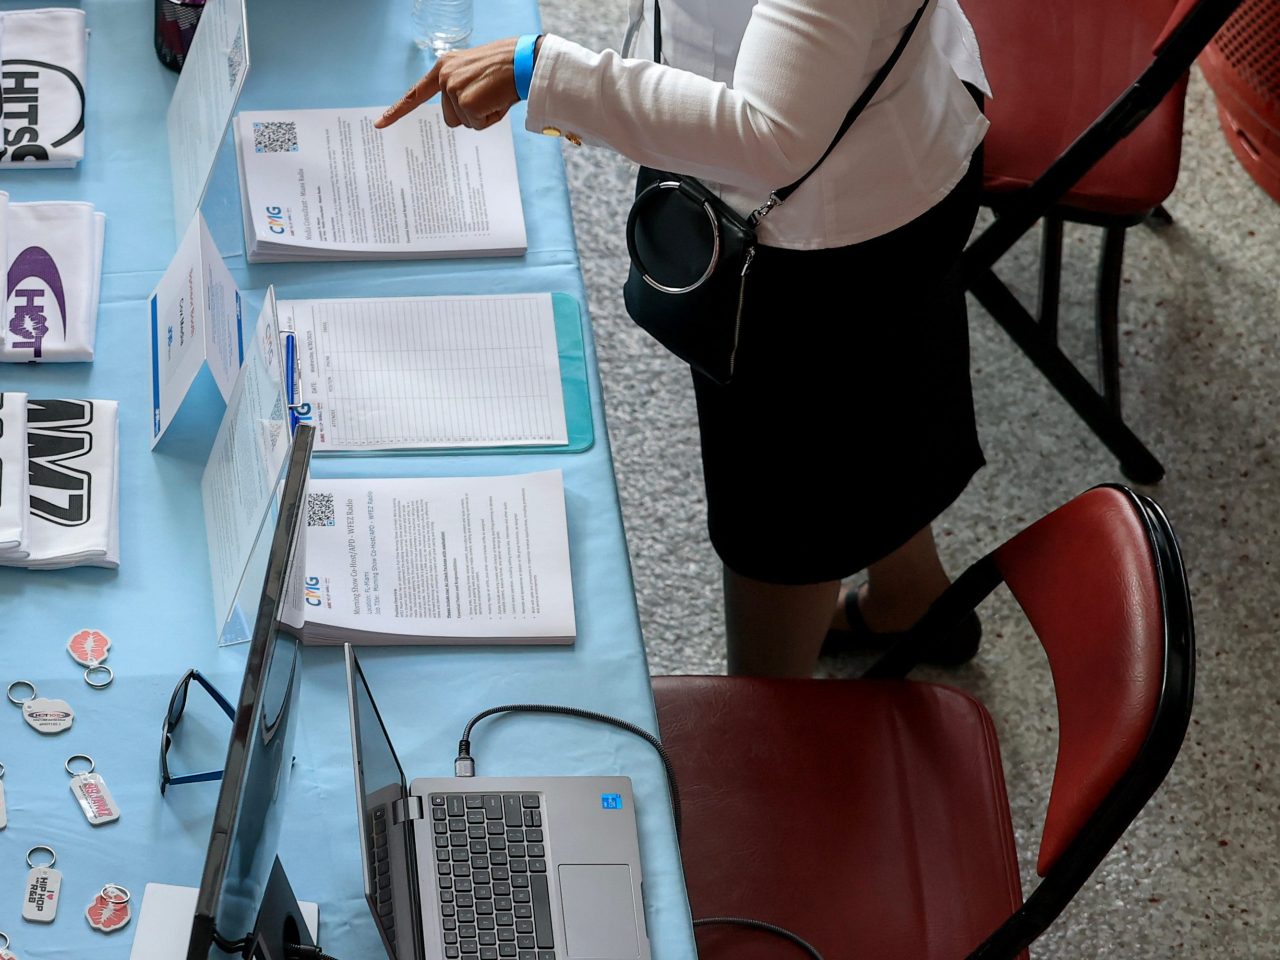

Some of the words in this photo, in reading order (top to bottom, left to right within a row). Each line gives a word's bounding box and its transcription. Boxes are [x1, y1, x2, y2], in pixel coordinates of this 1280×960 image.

[2, 71, 39, 144] HITS
[266, 206, 285, 234] CMG
[345, 498, 353, 515] Radio
[348, 539, 359, 577] Co-Host/APD
[305, 576, 322, 607] CMG
[351, 578, 359, 592] Show
[352, 592, 361, 615] Morning
[28, 883, 38, 904] R&B
[38, 877, 48, 892] HIP
[35, 892, 46, 912] HOP
